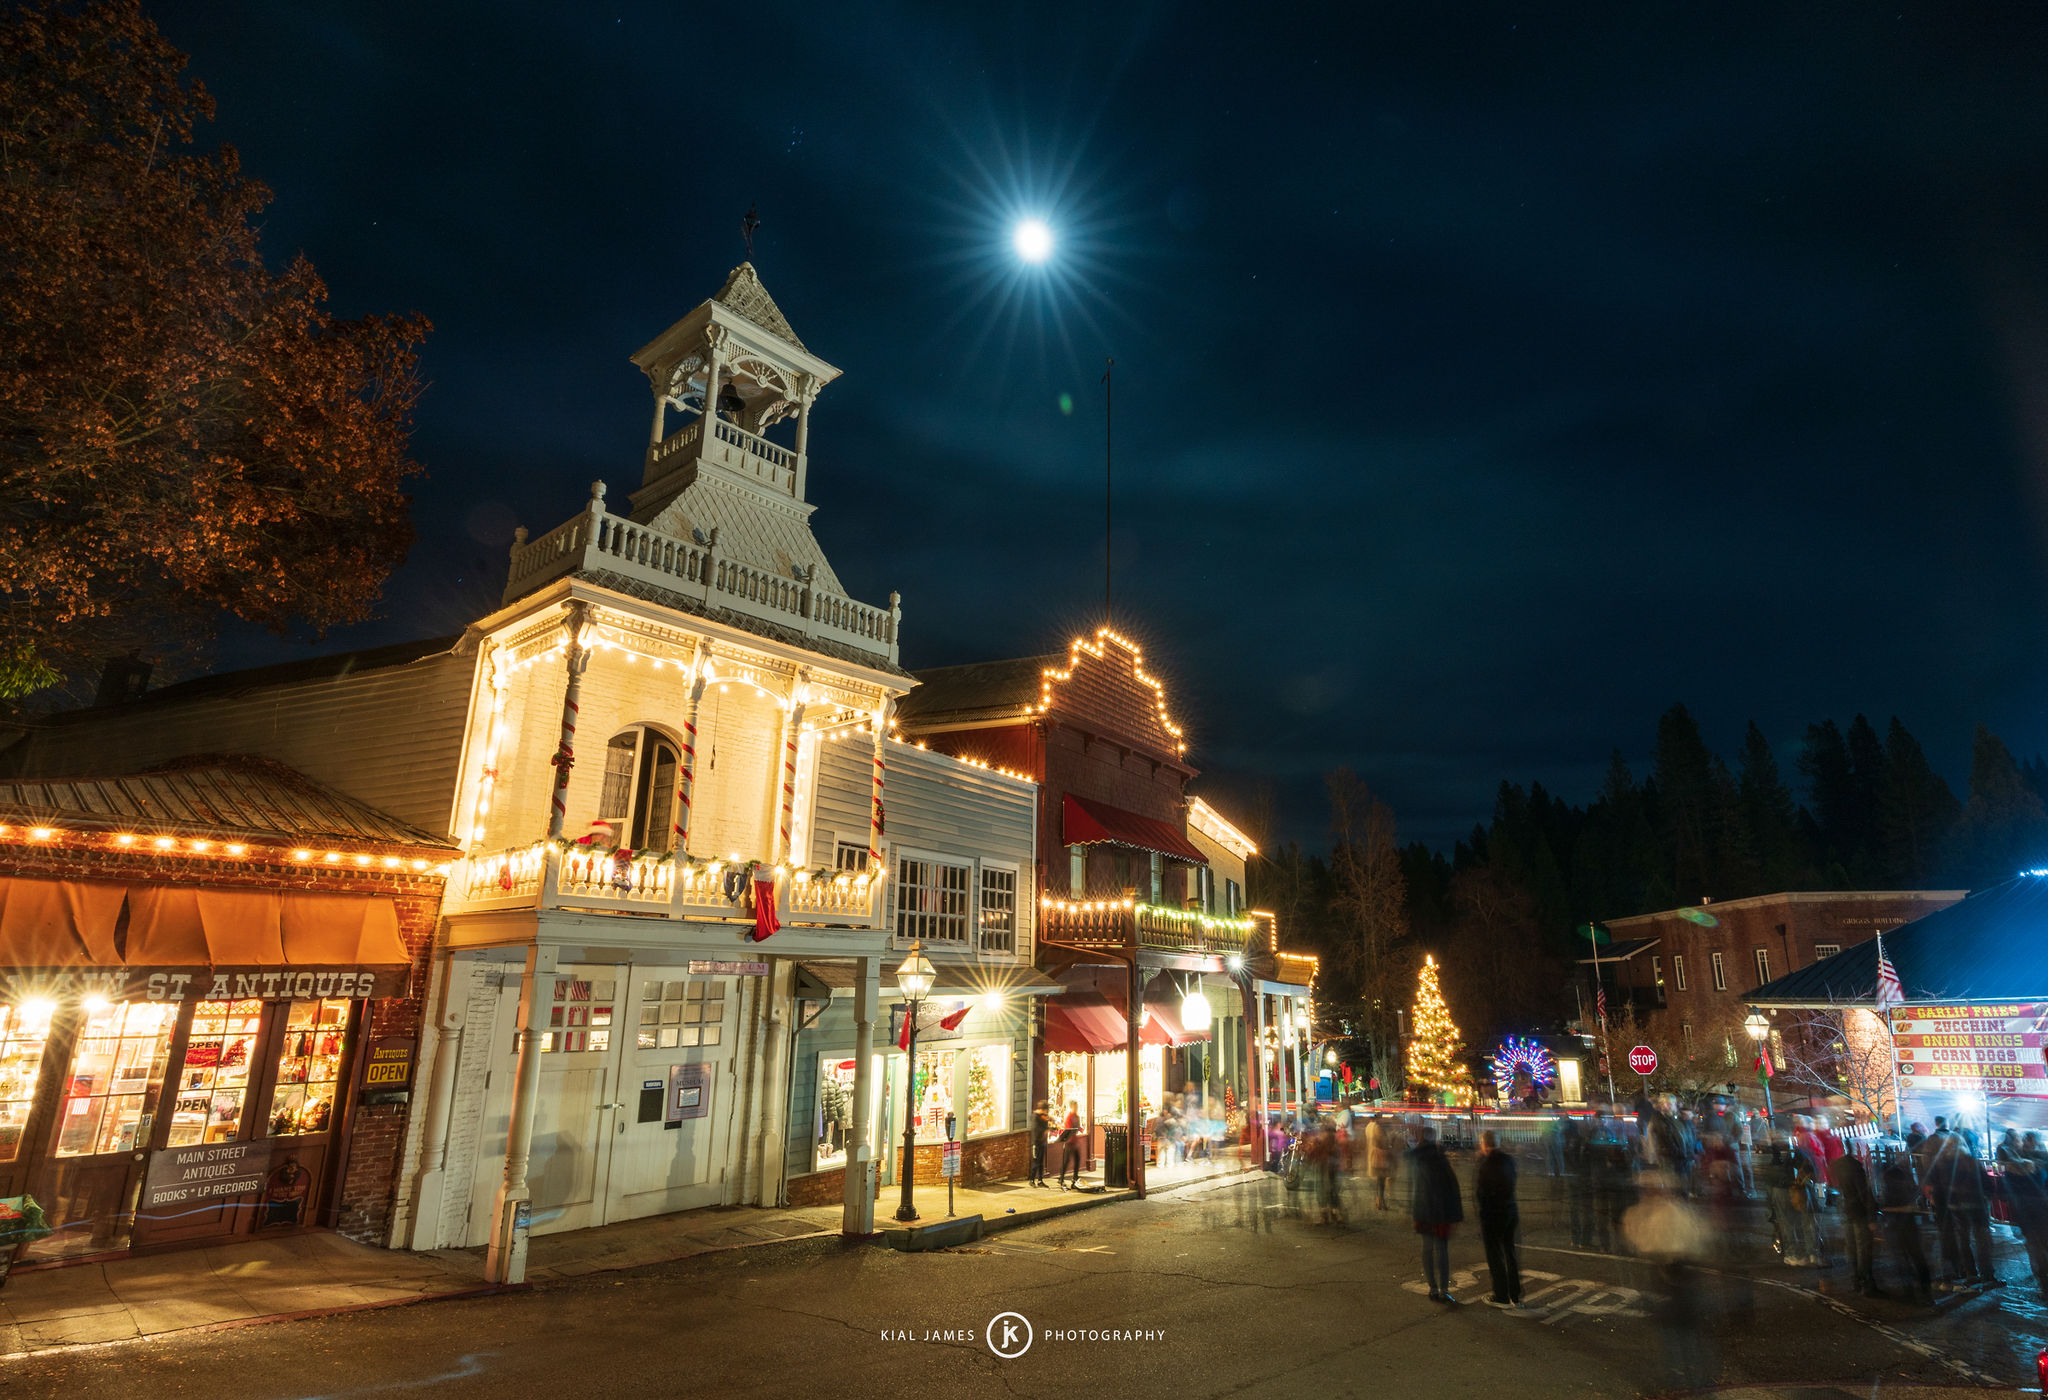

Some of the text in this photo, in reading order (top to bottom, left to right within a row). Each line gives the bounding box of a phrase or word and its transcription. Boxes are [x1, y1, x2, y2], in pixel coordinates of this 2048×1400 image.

[146, 974, 192, 999] ST
[204, 972, 377, 1000] ANTIQUES
[1917, 1004, 2020, 1019] GARLIC FRIES
[1933, 1019, 2007, 1033] ZUCCHINI
[1922, 1034, 2024, 1048] ONION RINGS
[1631, 1054, 1655, 1066] STOP
[1932, 1049, 2017, 1062] CORN DOGS
[369, 1064, 406, 1081] OPEN
[1931, 1063, 2025, 1078] ASPARAGUS
[1940, 1078, 2017, 1092] PRETZELS
[177, 1146, 248, 1165] MAIN STREET
[182, 1163, 236, 1180] ANTIQUES
[152, 1189, 188, 1204] BOOKS
[197, 1185, 211, 1197] LP
[212, 1180, 258, 1195] RECORDS
